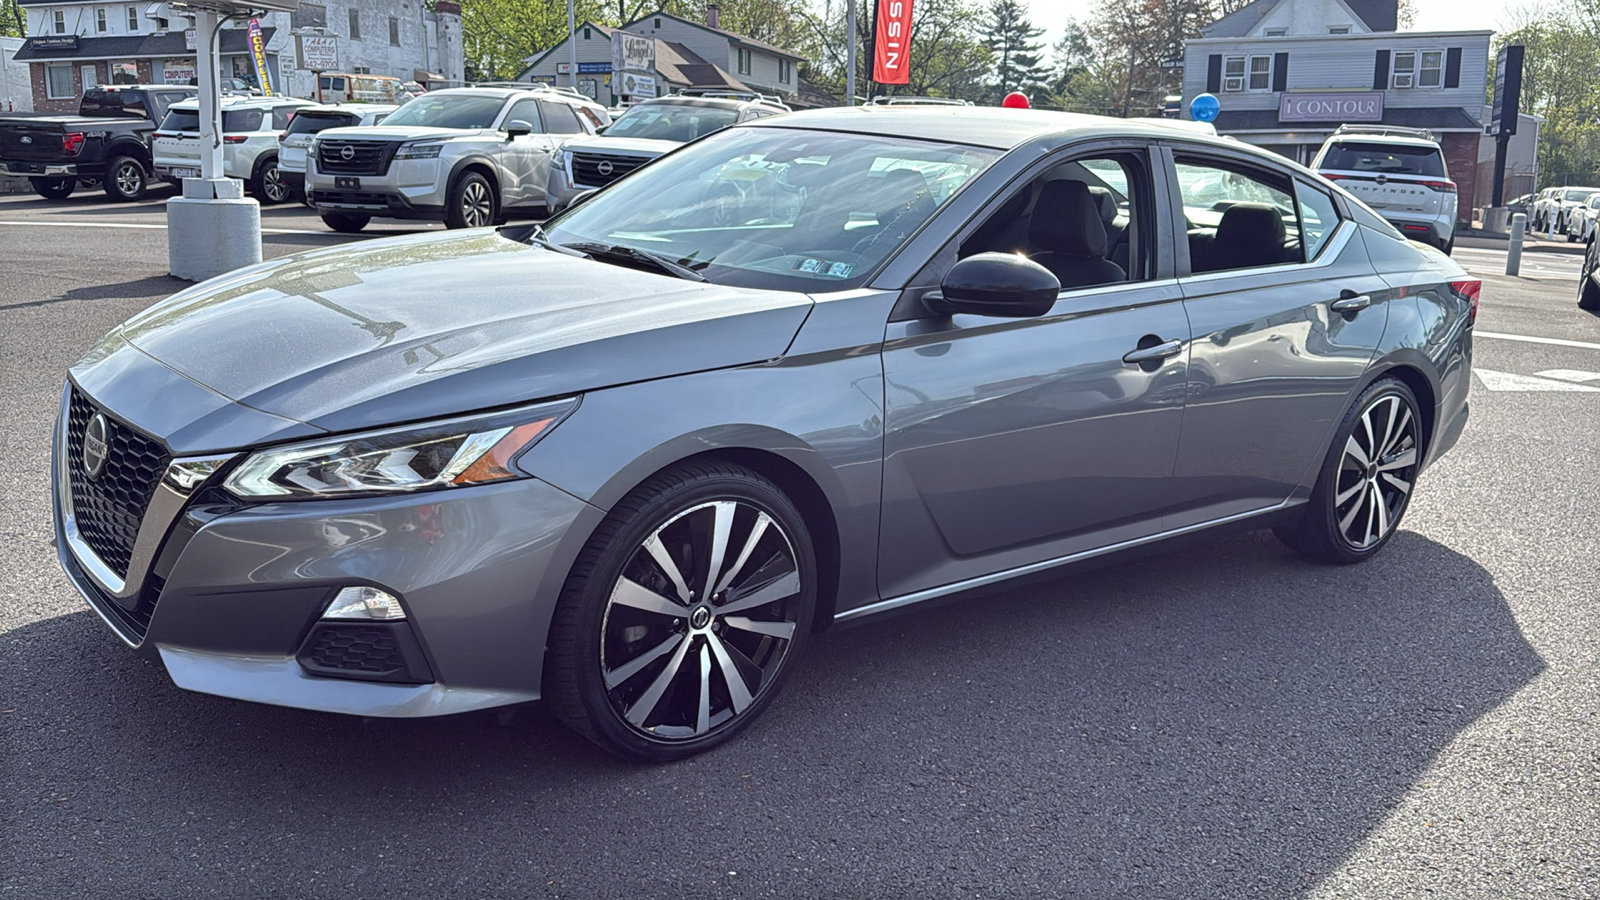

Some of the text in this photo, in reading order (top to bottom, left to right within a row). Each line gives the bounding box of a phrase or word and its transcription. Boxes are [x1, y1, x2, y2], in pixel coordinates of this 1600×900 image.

[164, 70, 194, 79] COMPUTERS
[1296, 100, 1375, 114] CONTOUR
[1344, 185, 1425, 195] ATHFINDER
